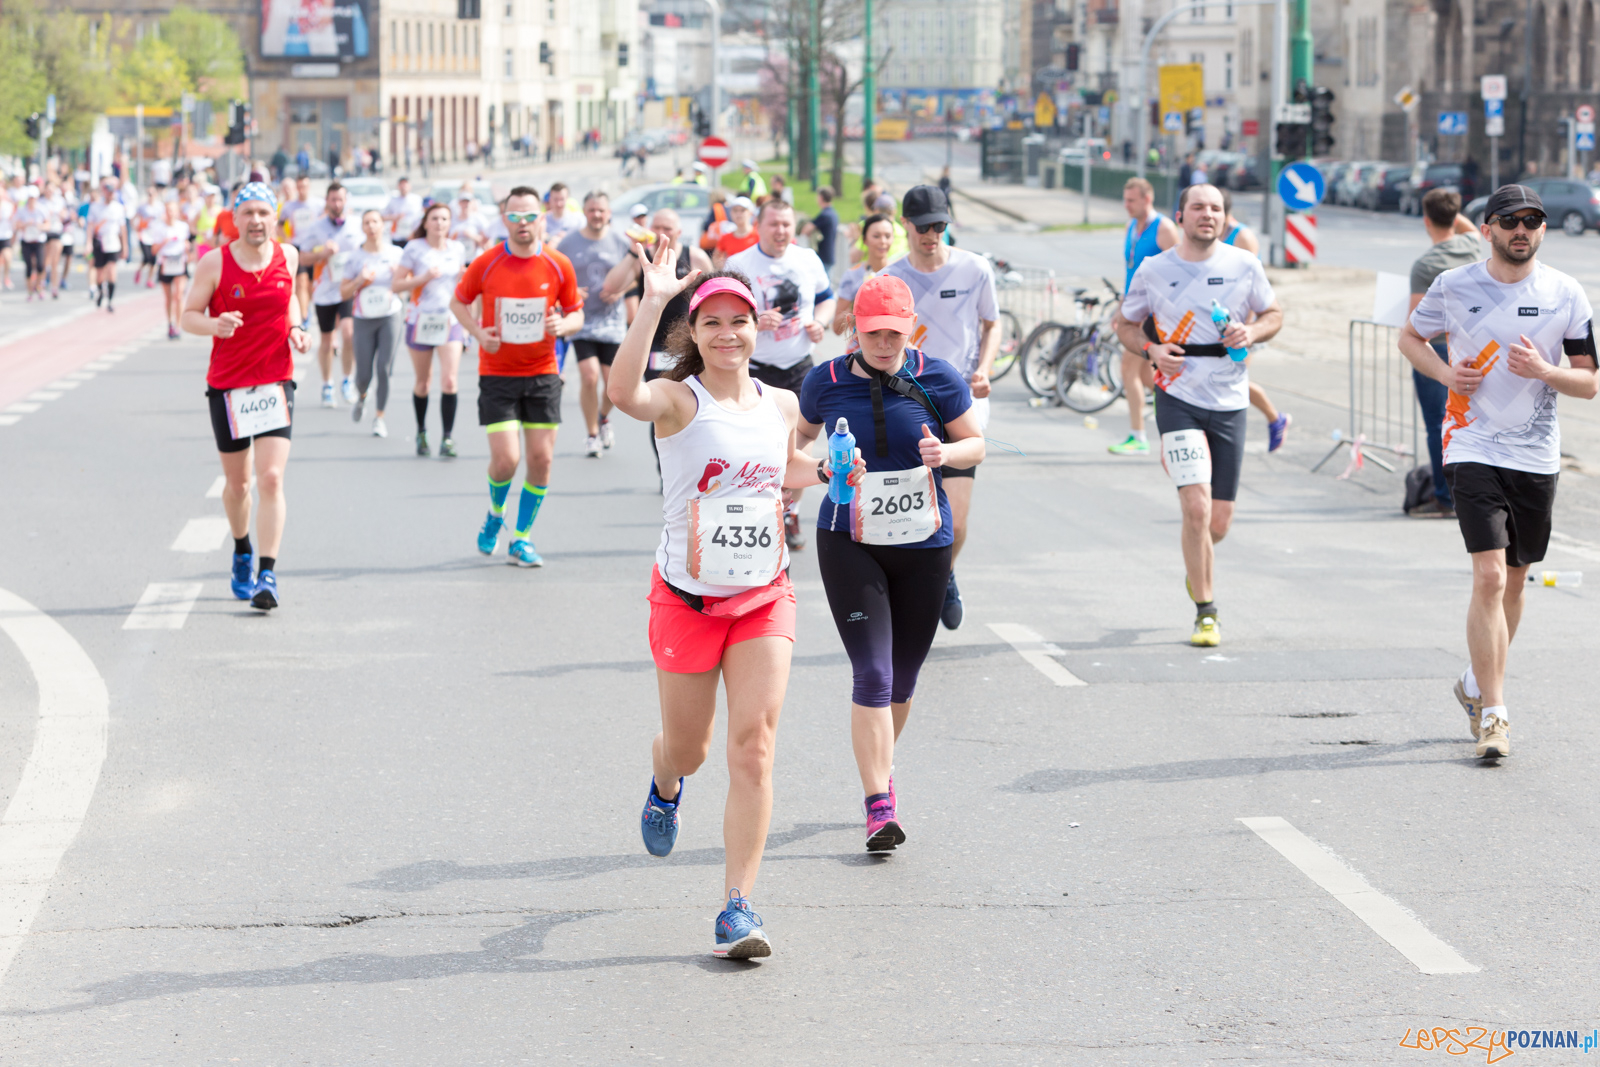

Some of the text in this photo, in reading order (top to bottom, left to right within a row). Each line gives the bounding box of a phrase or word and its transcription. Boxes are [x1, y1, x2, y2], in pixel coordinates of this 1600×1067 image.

[505, 312, 543, 324] 10507
[240, 396, 277, 414] 4409
[1168, 447, 1205, 463] 11362
[732, 461, 781, 480] Mamy
[871, 491, 924, 516] 2603
[712, 526, 771, 548] 4336
[733, 552, 752, 560] Basia
